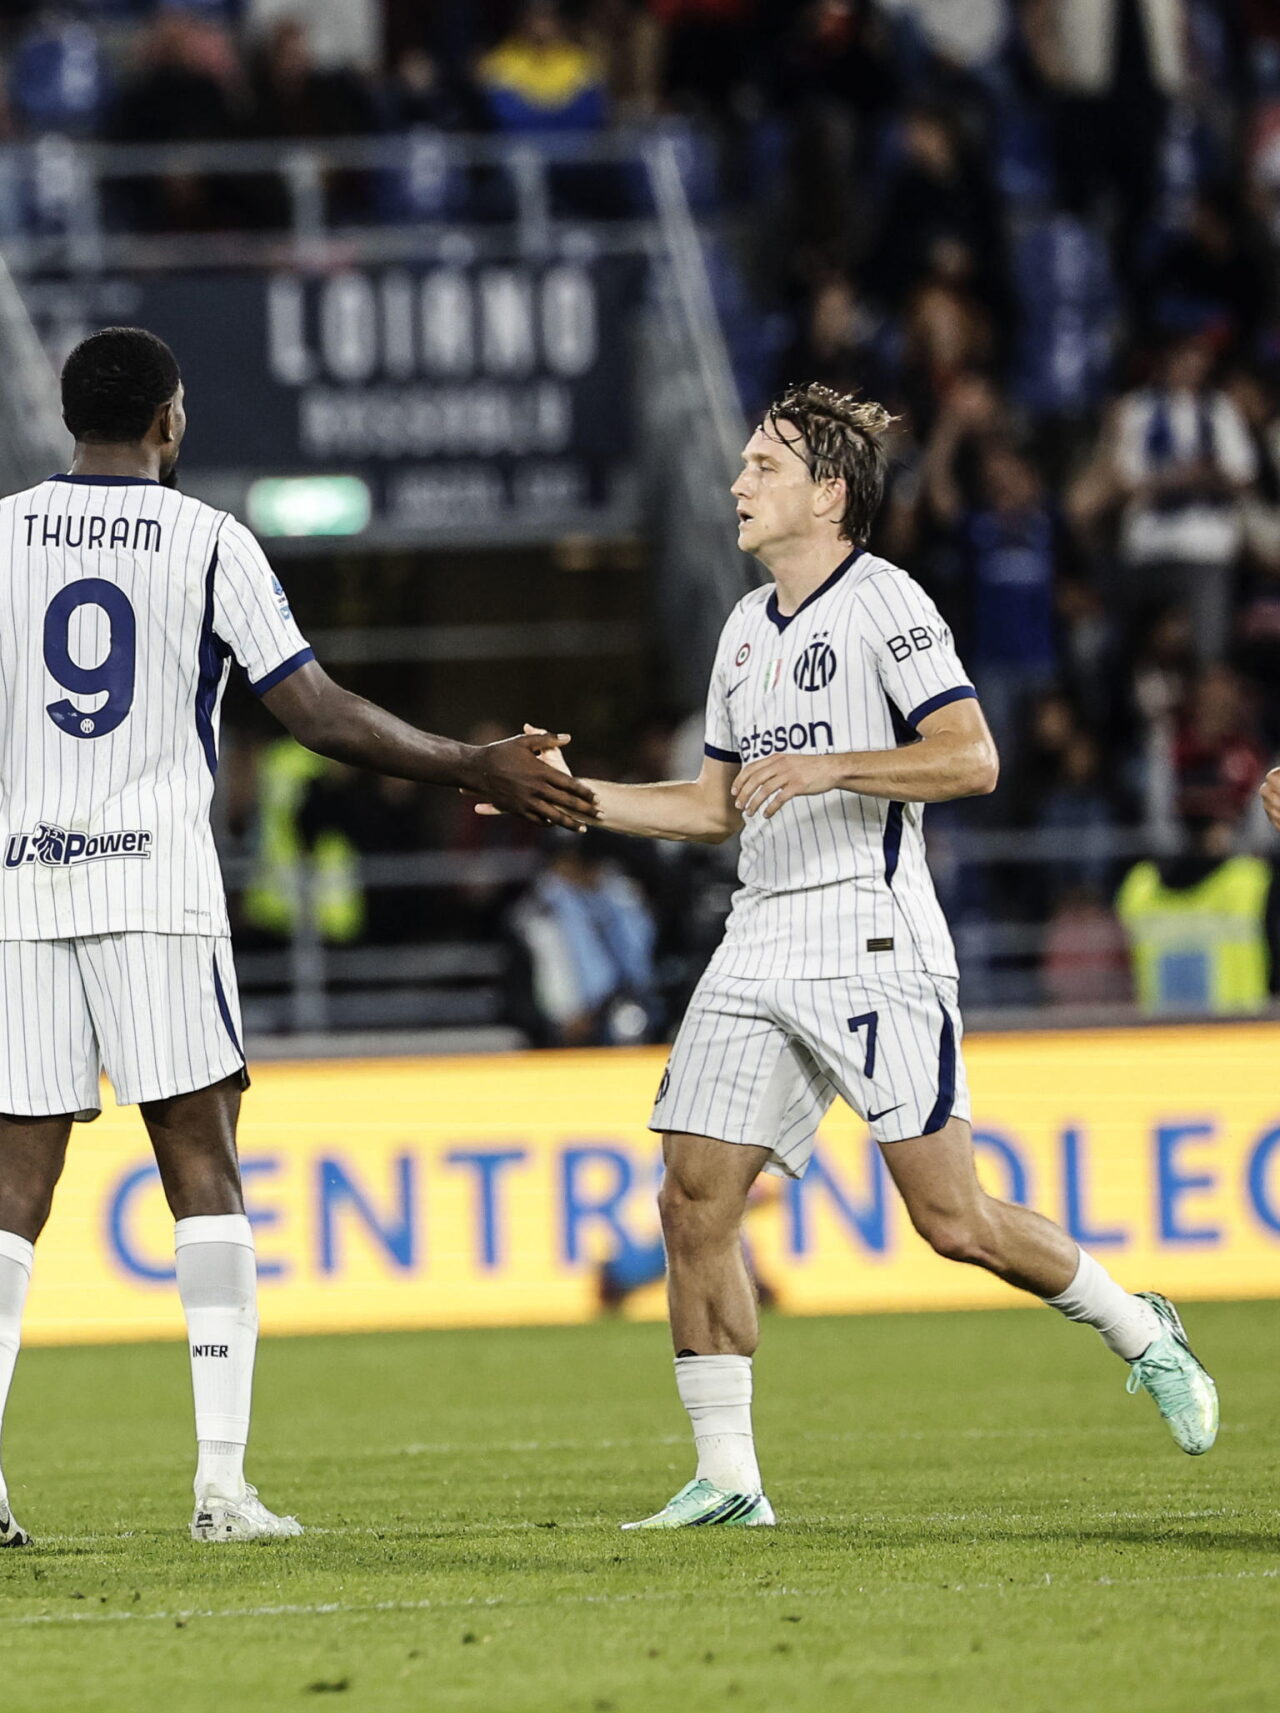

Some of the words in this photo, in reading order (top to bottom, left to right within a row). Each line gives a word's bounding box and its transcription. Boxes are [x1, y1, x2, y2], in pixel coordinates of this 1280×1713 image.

[24, 514, 163, 553] THURAM
[43, 578, 136, 739] 9
[739, 720, 834, 763] etsson
[848, 1010, 879, 1080] 7
[192, 1345, 228, 1358] INTER
